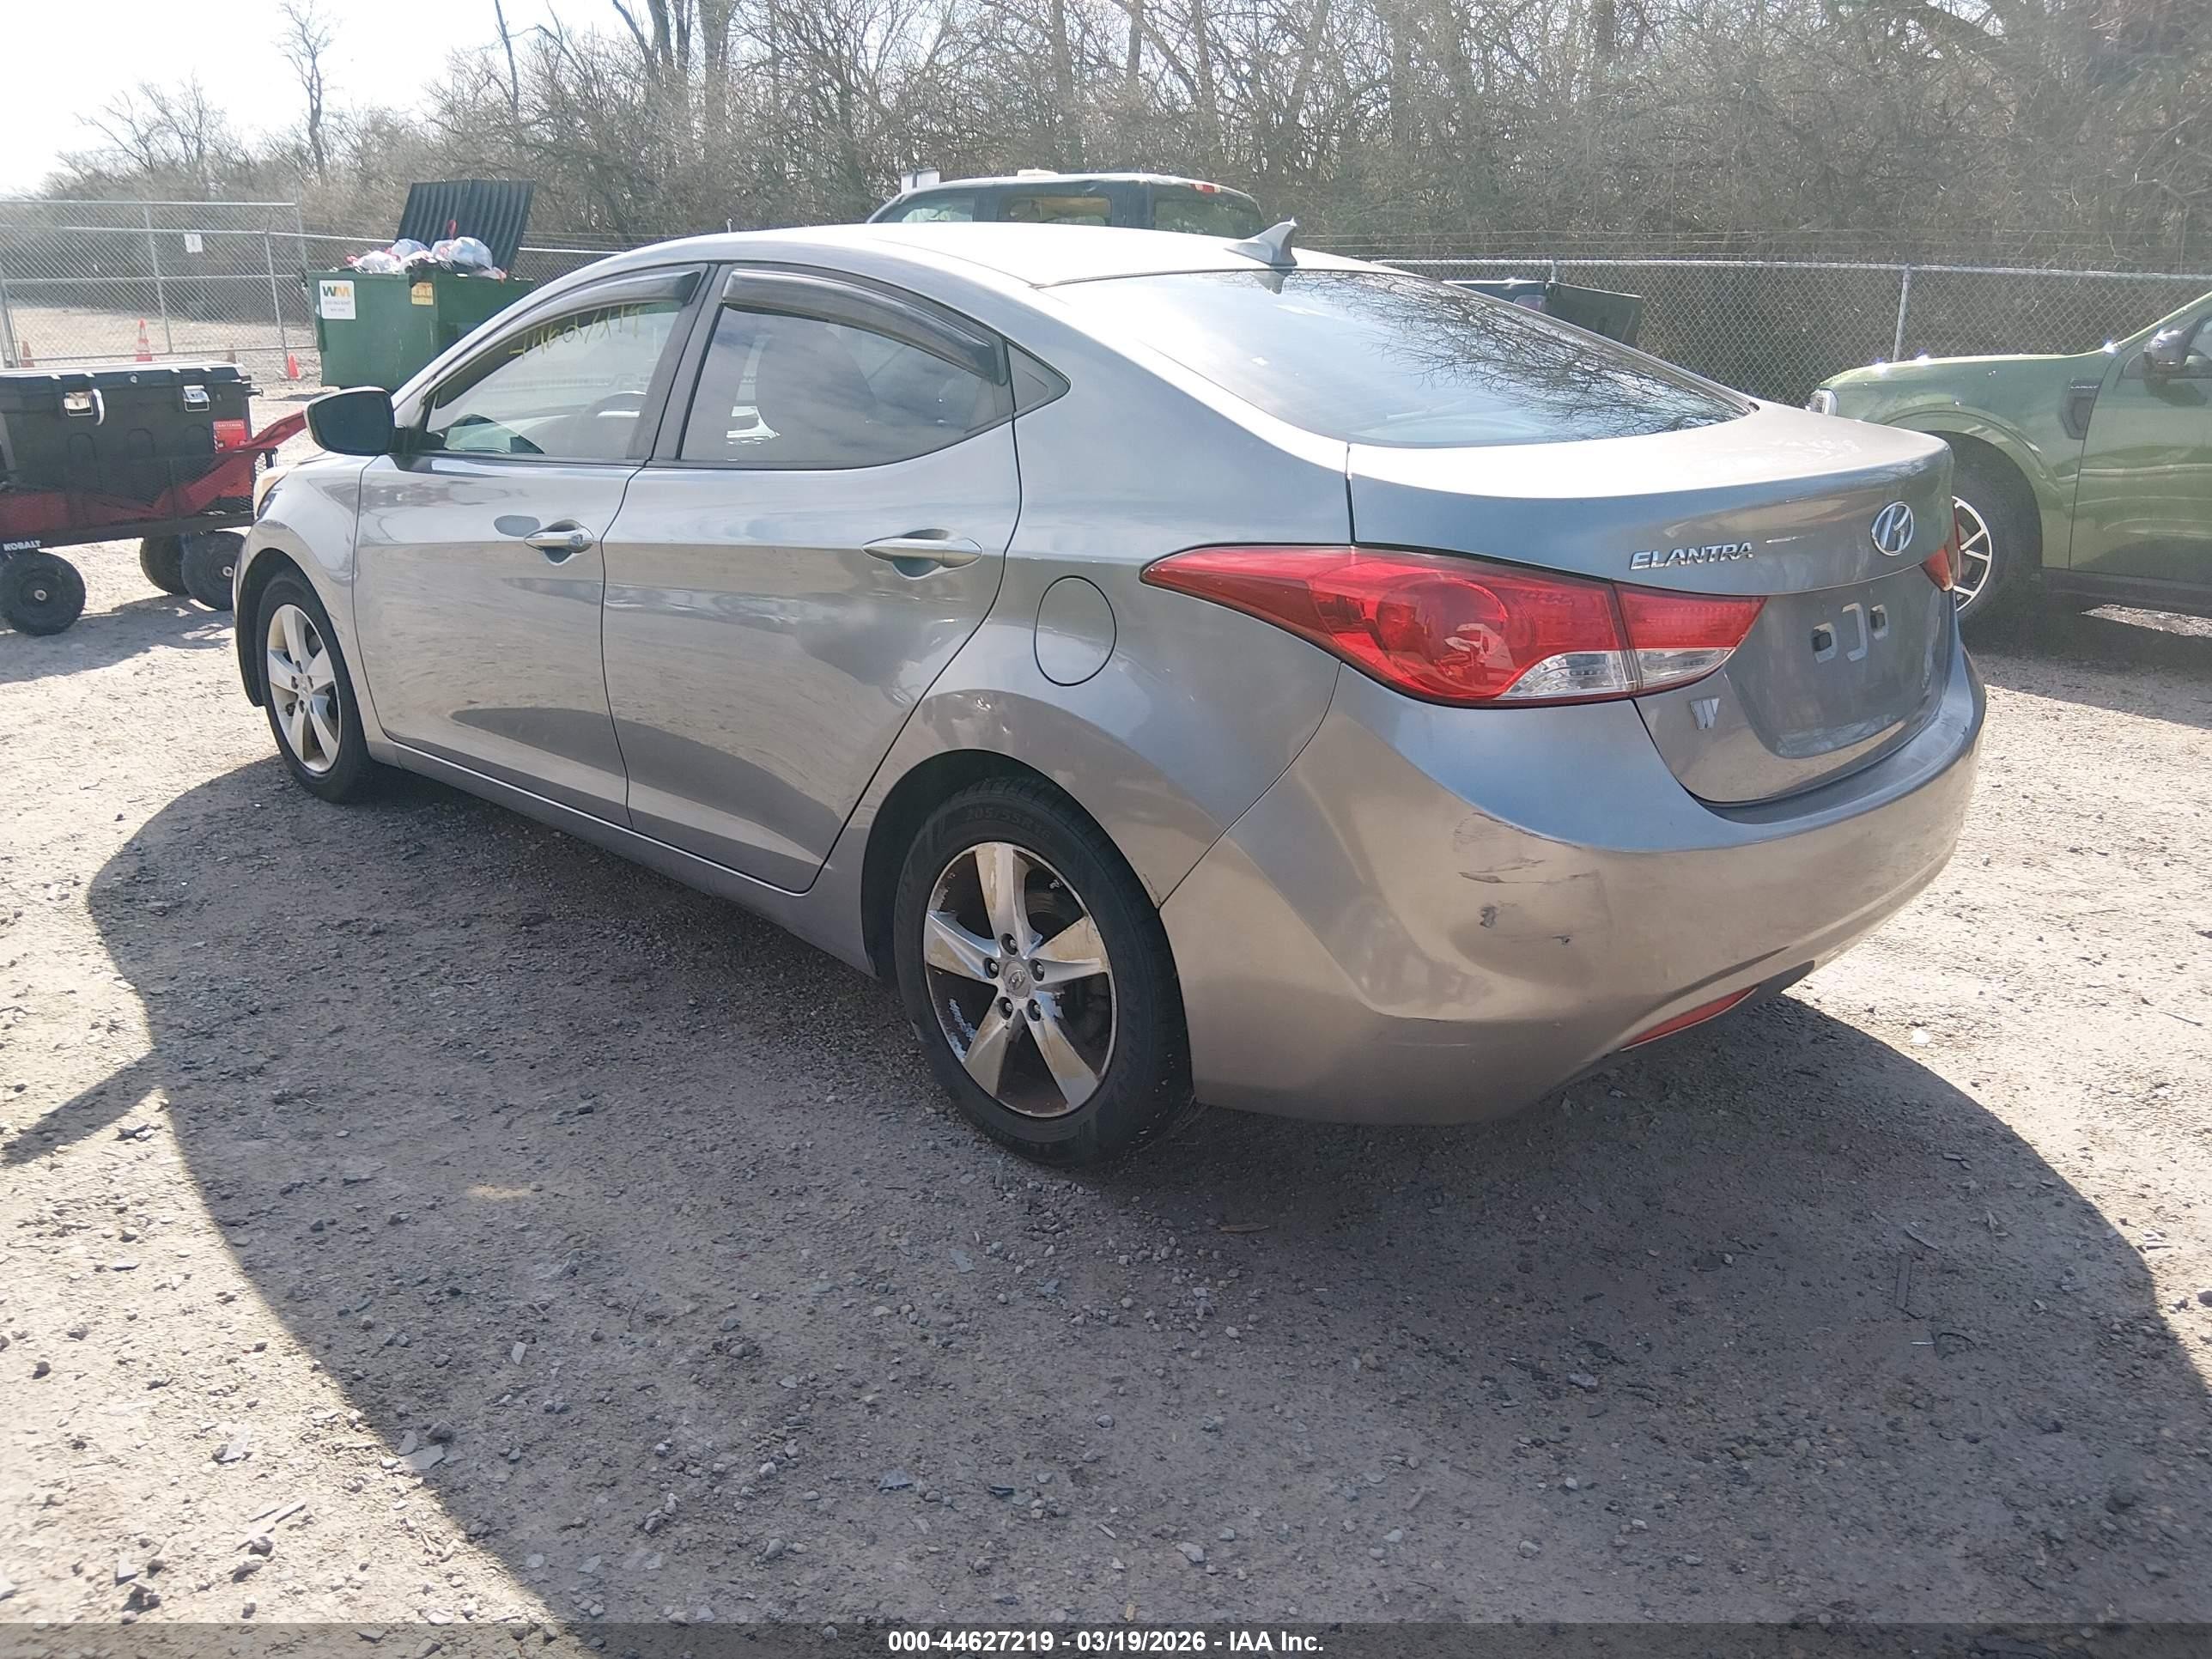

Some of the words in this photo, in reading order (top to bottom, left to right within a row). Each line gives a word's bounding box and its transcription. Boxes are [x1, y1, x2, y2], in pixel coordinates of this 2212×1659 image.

[322, 285, 350, 297] WM
[3, 540, 41, 551] KOBALT
[1630, 542, 1753, 571] ELANTRA
